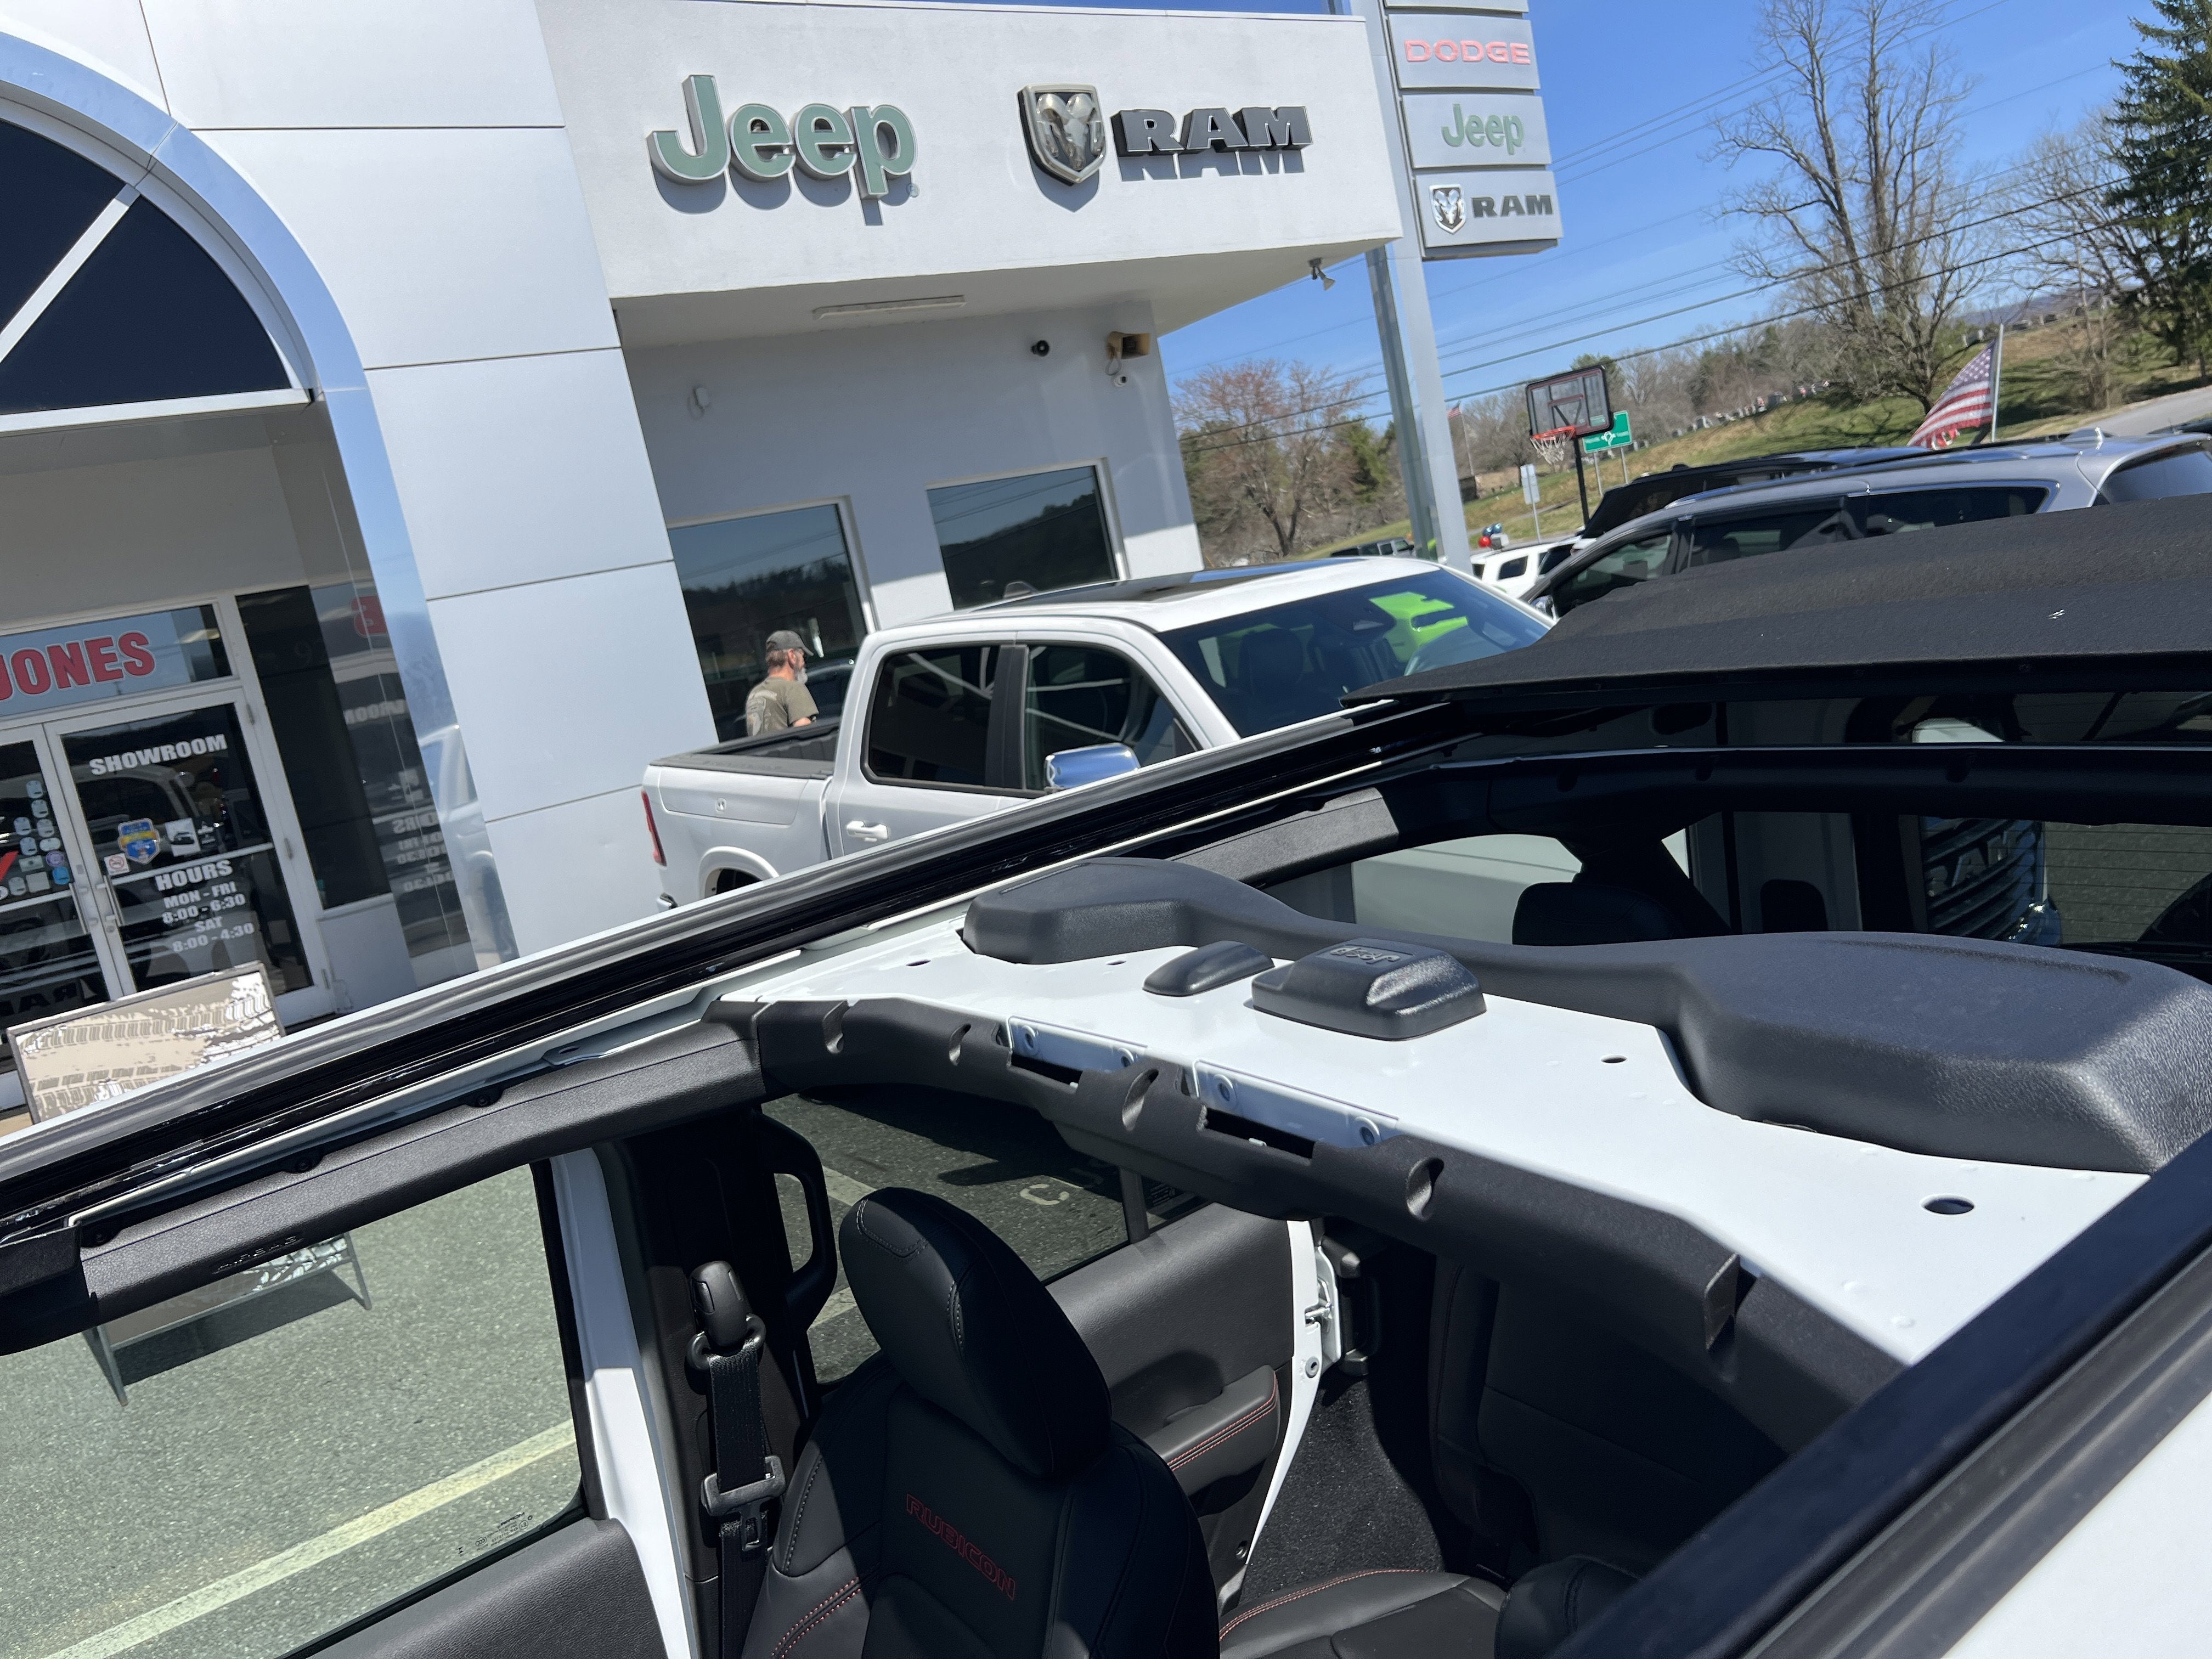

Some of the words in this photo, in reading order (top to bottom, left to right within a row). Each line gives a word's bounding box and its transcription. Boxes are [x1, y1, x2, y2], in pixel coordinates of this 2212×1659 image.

[1404, 40, 1531, 65] DODGE
[646, 74, 918, 200] Jeep
[1110, 105, 1313, 157] RAM
[1441, 103, 1525, 155] Jeep
[1470, 194, 1553, 218] RAM
[89, 733, 228, 775] SHOWROOM
[155, 860, 233, 891] HOURS
[163, 890, 201, 909] MON
[211, 881, 237, 897] FRI
[162, 905, 199, 924] 8:00
[194, 916, 223, 932] SAT
[172, 935, 208, 952] 8:00
[221, 923, 255, 940] 4:30
[906, 1493, 1015, 1601] RUBICON
